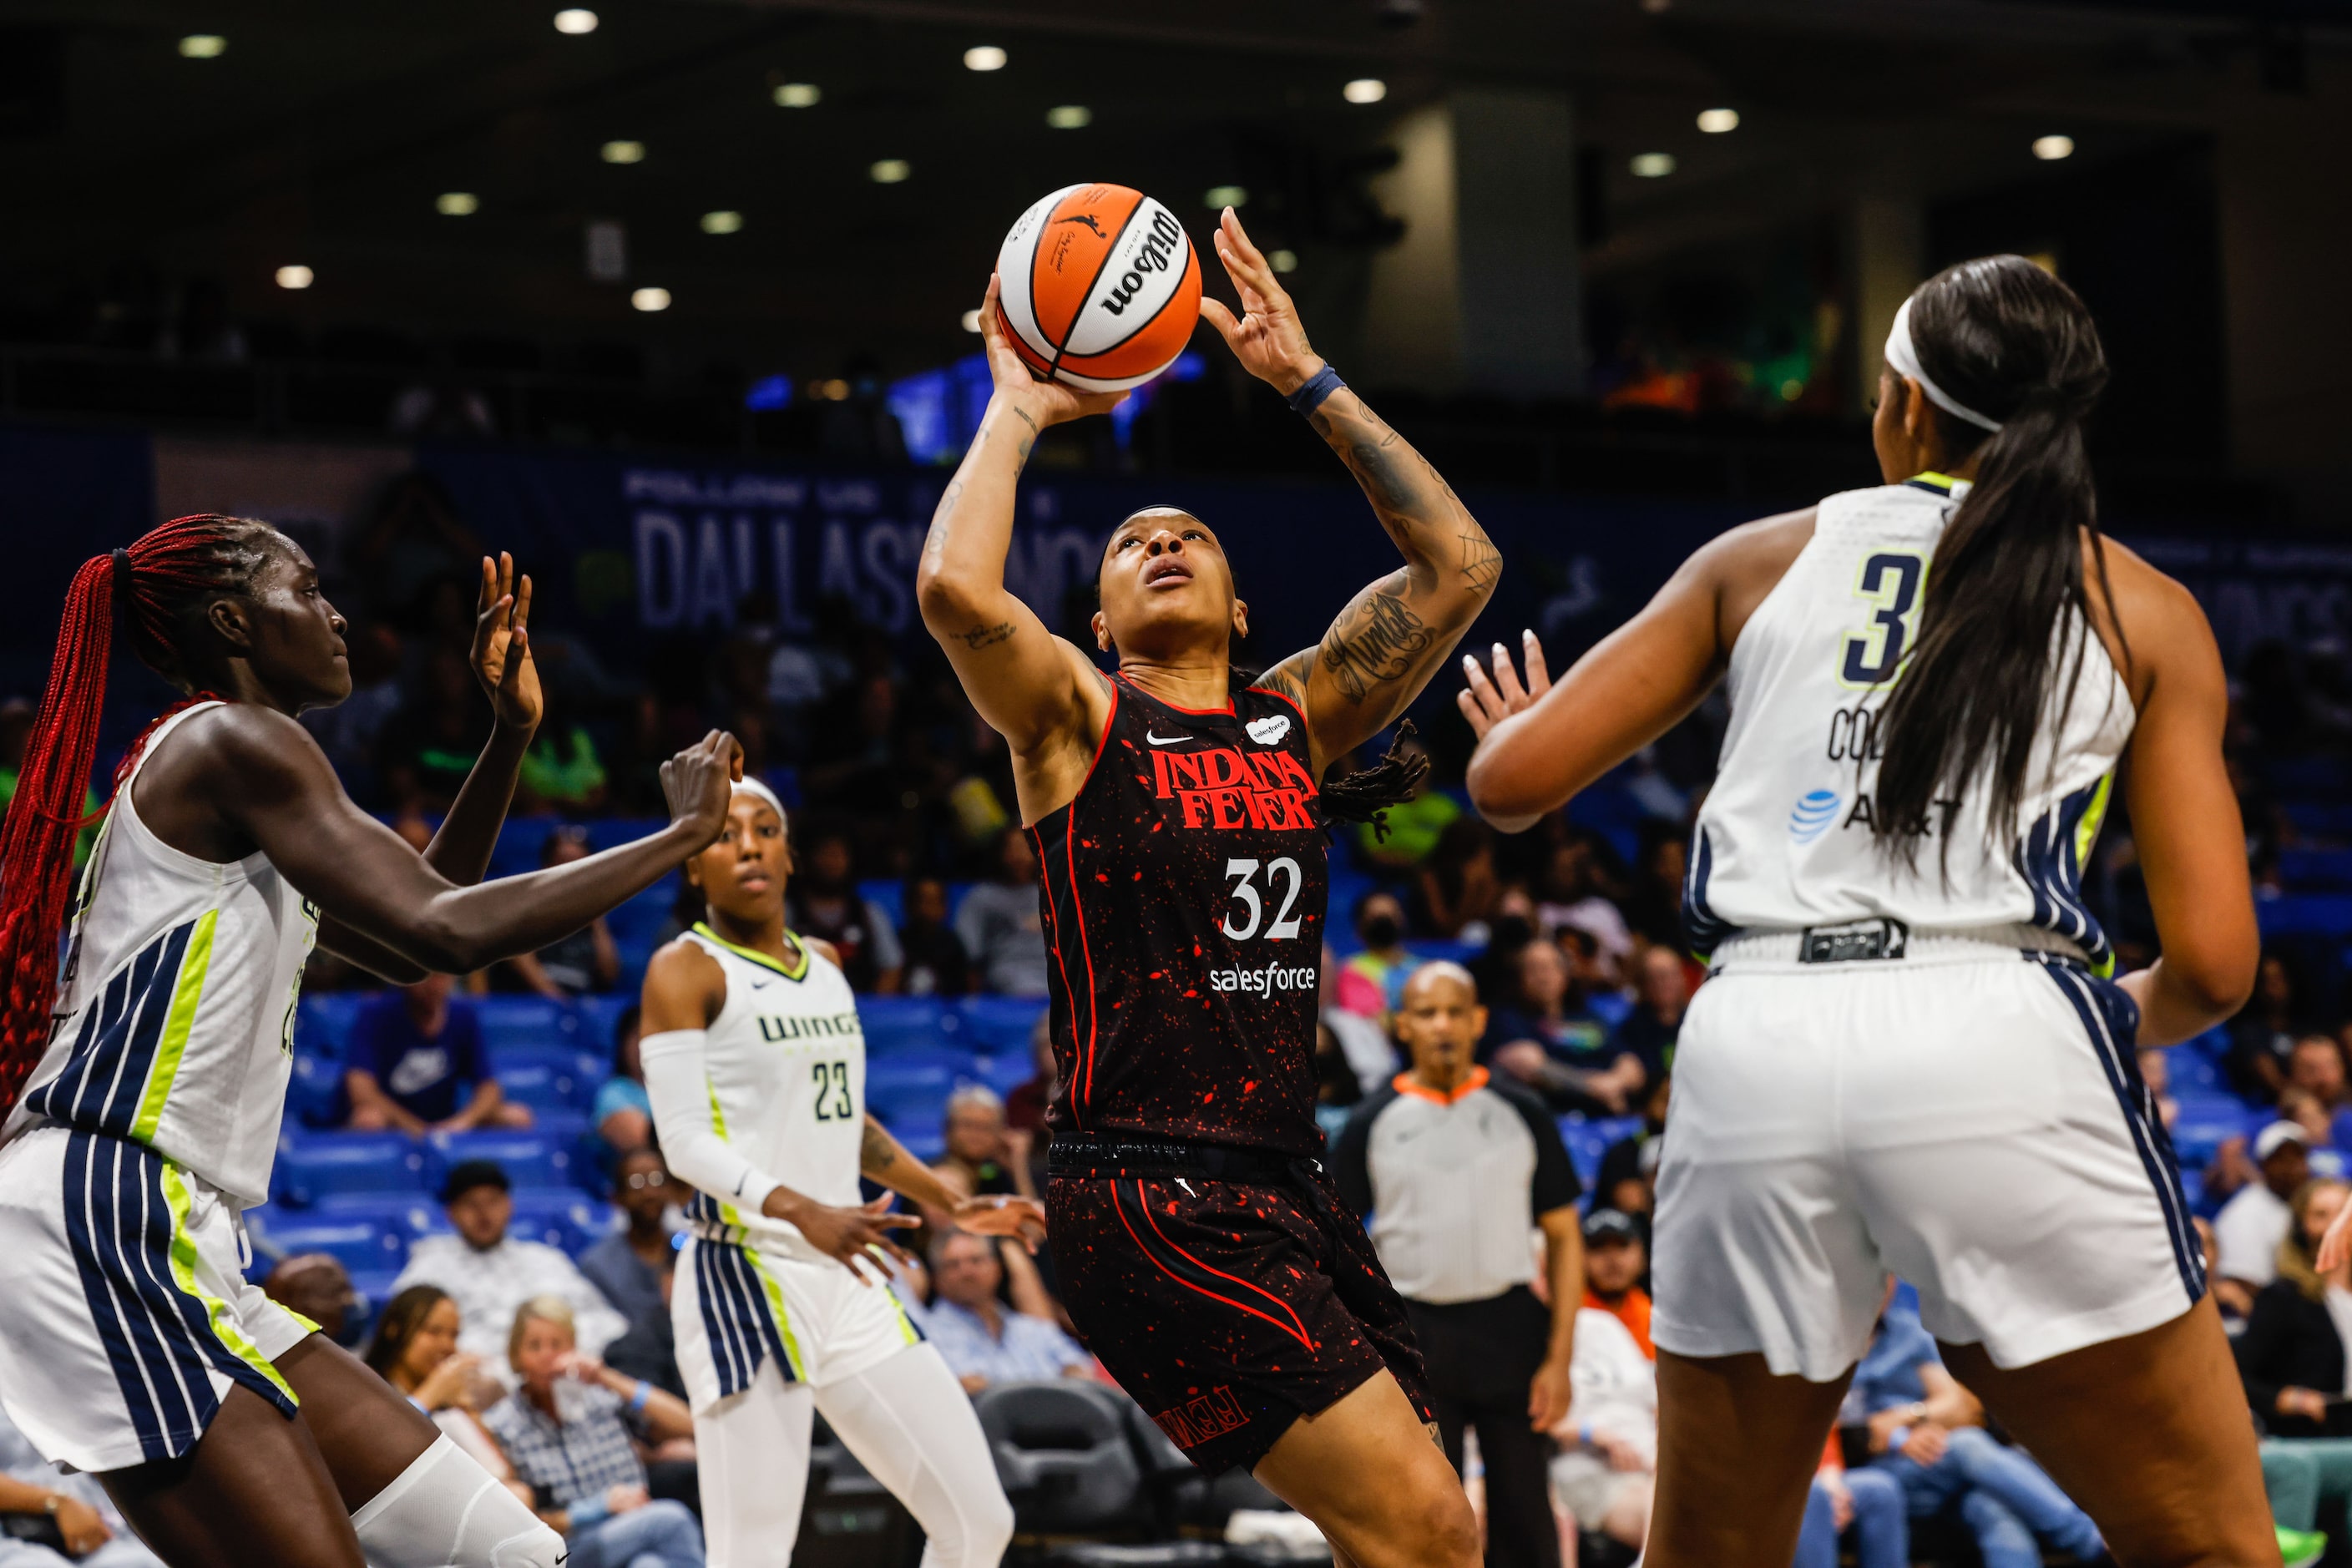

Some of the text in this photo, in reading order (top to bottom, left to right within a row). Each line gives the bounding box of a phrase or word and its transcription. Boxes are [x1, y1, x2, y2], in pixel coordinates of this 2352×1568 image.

[1101, 210, 1180, 316] Wilson
[1838, 551, 1925, 688] 3
[1253, 719, 1287, 738] salesforce
[1149, 745, 1319, 802] INDANA
[1176, 786, 1316, 831] FEVER
[1222, 857, 1302, 941] 32
[1210, 961, 1315, 999] salesforce
[812, 1060, 853, 1121] 23
